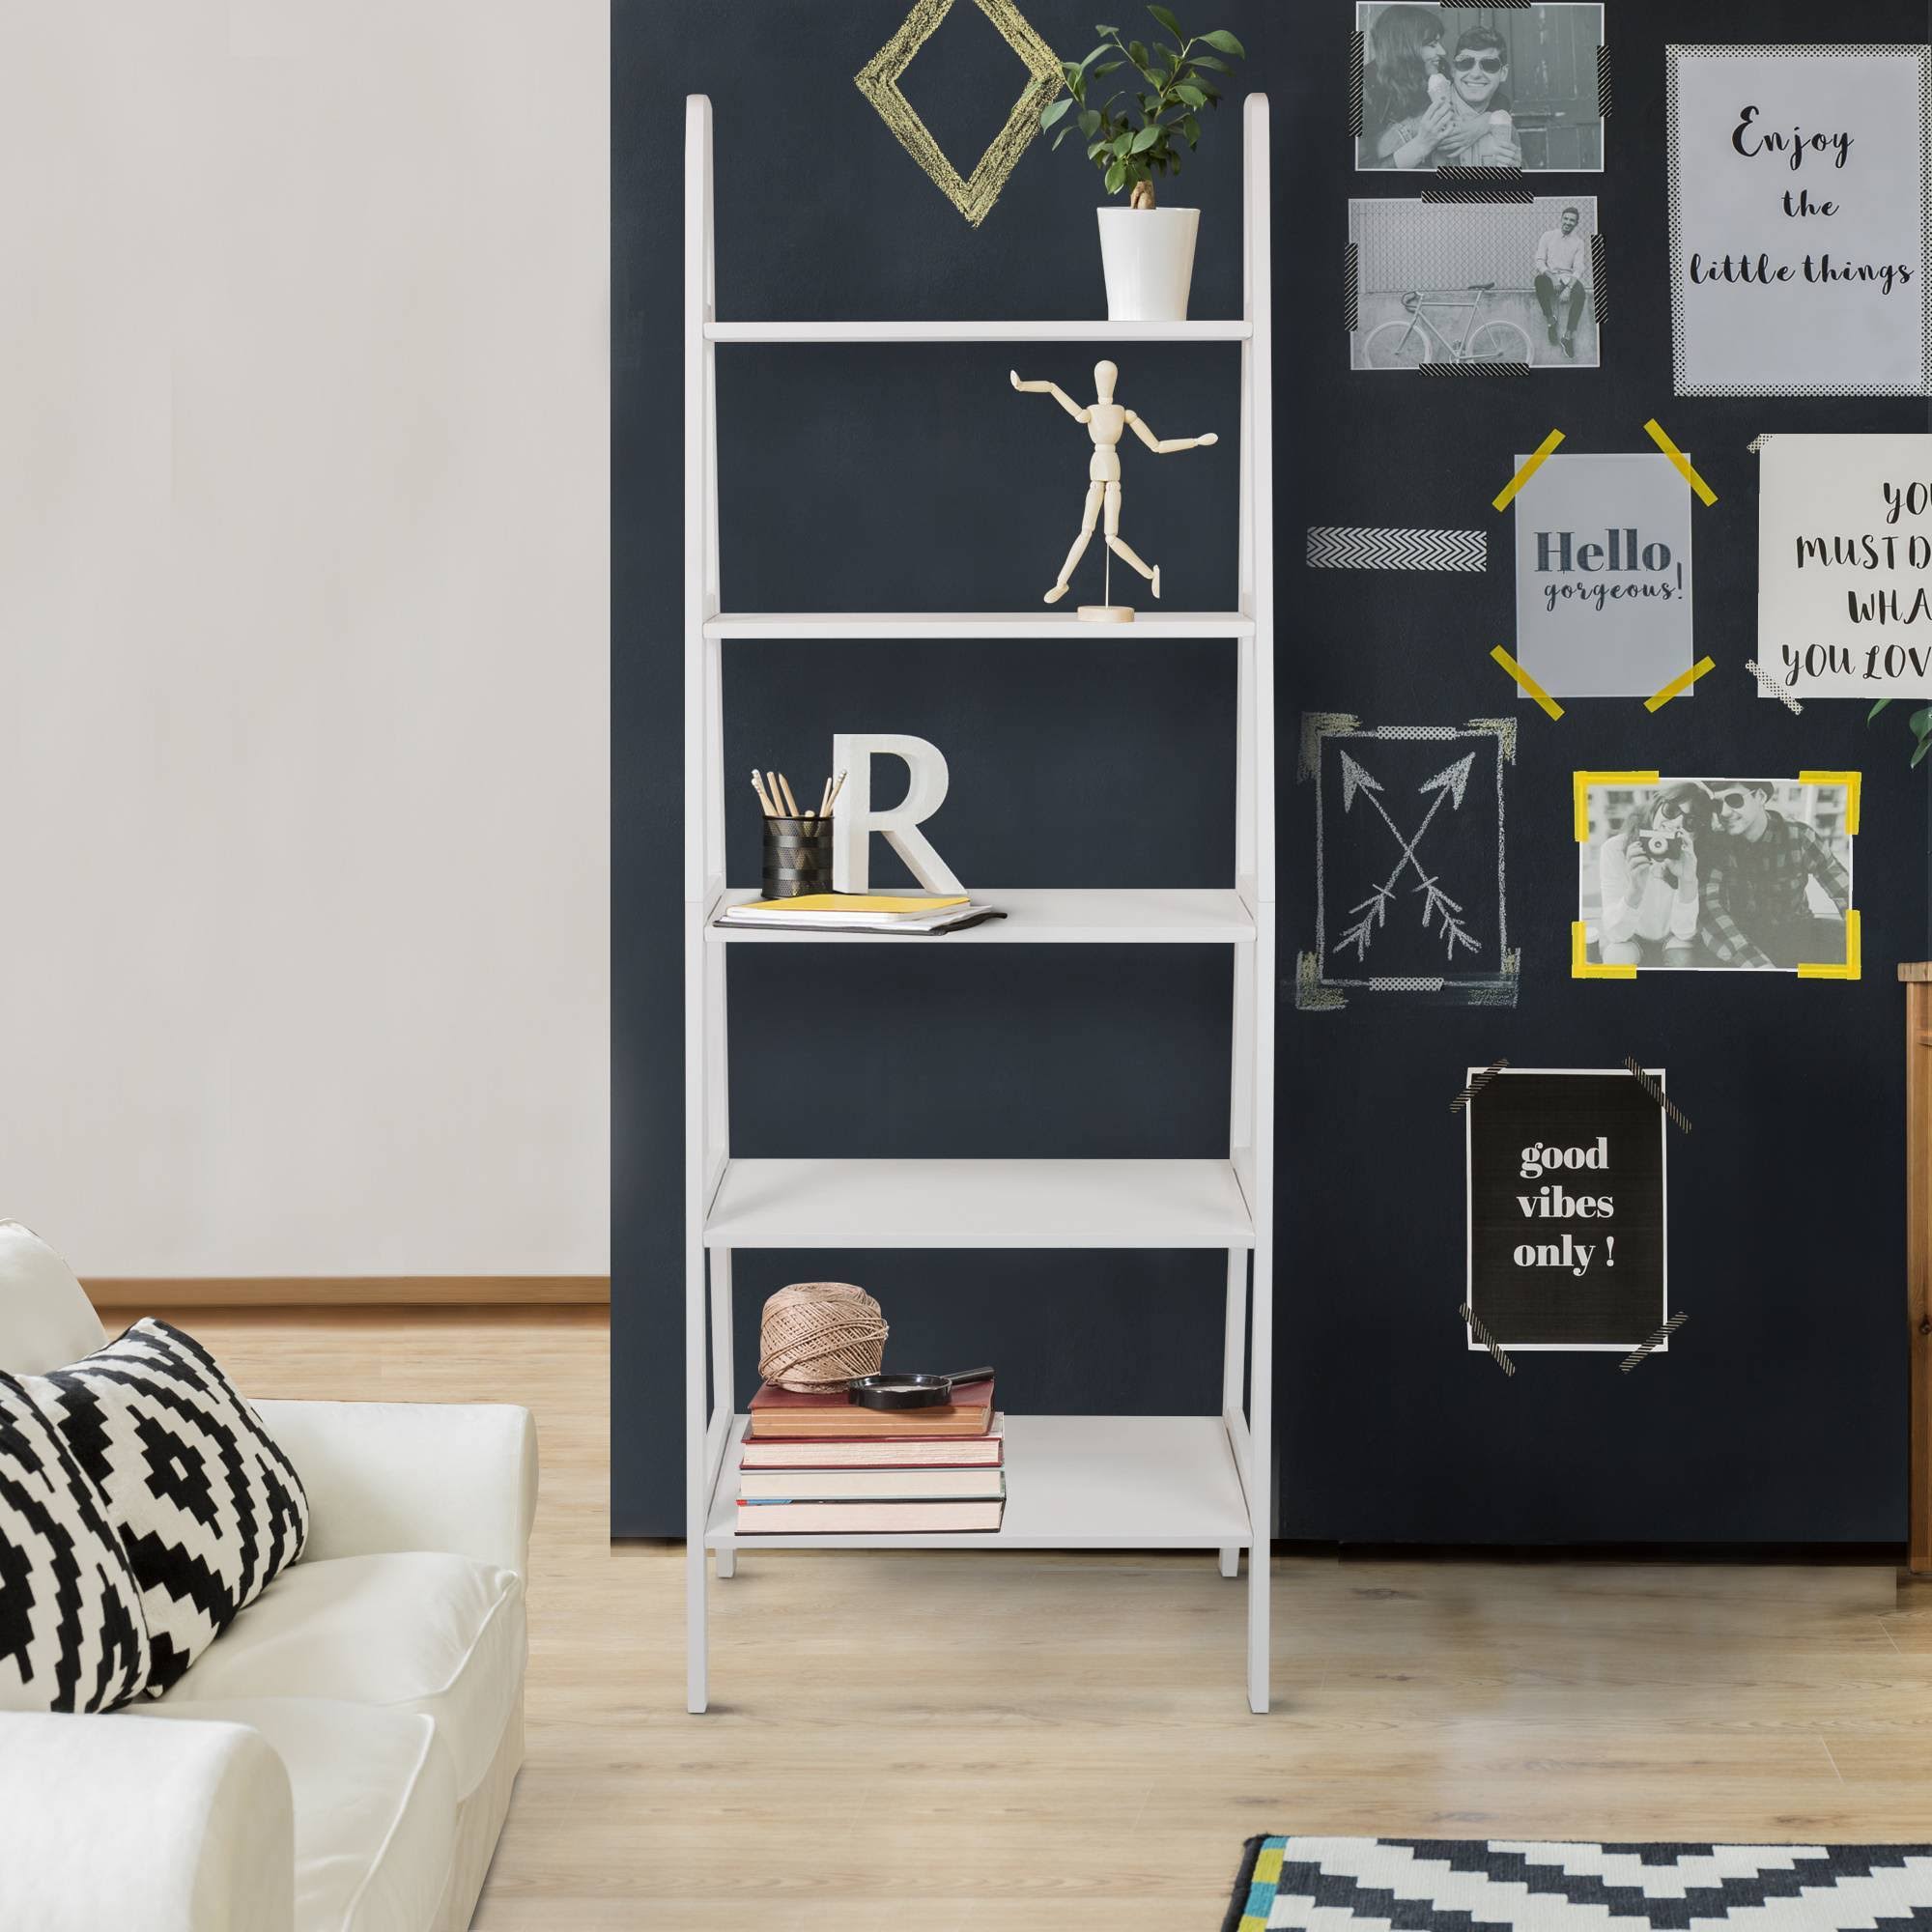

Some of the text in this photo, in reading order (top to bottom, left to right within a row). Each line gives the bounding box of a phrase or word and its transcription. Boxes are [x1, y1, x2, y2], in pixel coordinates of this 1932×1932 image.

[1732, 105, 1855, 171] Enjoy
[1781, 189, 1840, 217] the
[1690, 253, 1915, 296] little things
[1883, 481, 1932, 525] YO
[1533, 527, 1672, 573] Hello
[1796, 534, 1900, 571] MUST
[1544, 561, 1684, 612] gorgeous!
[1781, 643, 1857, 687] YOU
[833, 733, 968, 895] R
[1520, 1136, 1610, 1179] good
[1516, 1184, 1614, 1218] vibes
